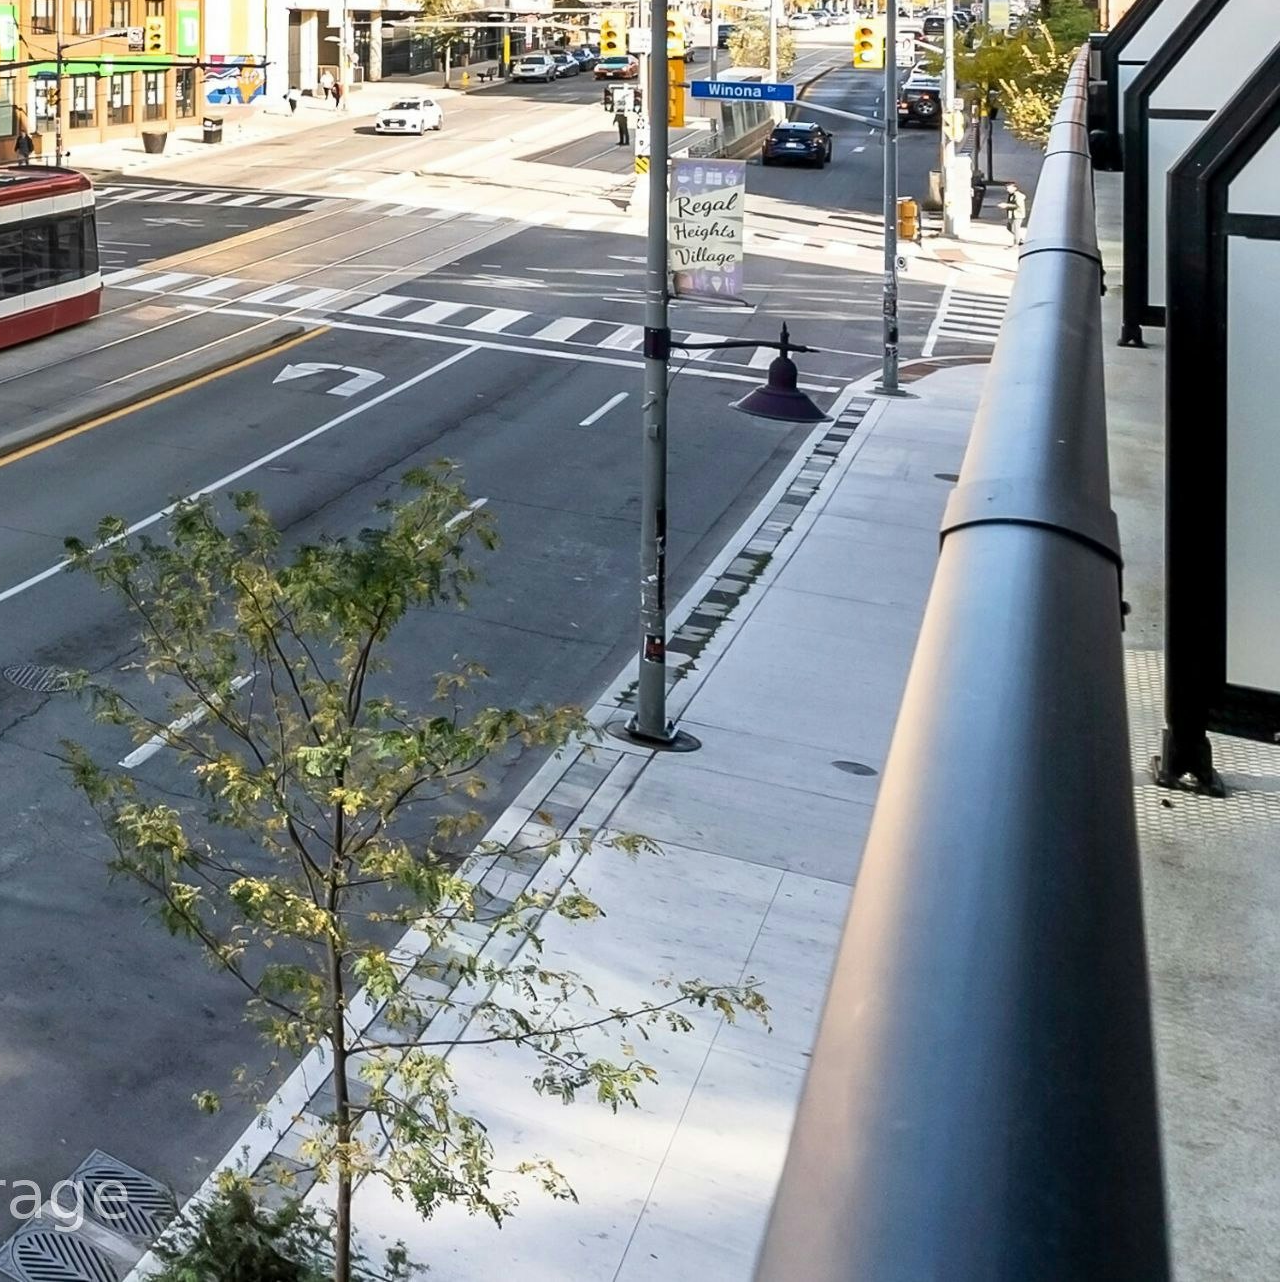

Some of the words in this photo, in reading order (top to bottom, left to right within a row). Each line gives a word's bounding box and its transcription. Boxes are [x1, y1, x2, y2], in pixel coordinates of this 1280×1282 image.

[708, 83, 762, 97] Winona
[767, 85, 776, 93] Dr
[674, 192, 739, 218] Regal
[673, 221, 736, 242] Heights
[675, 246, 735, 266] Village
